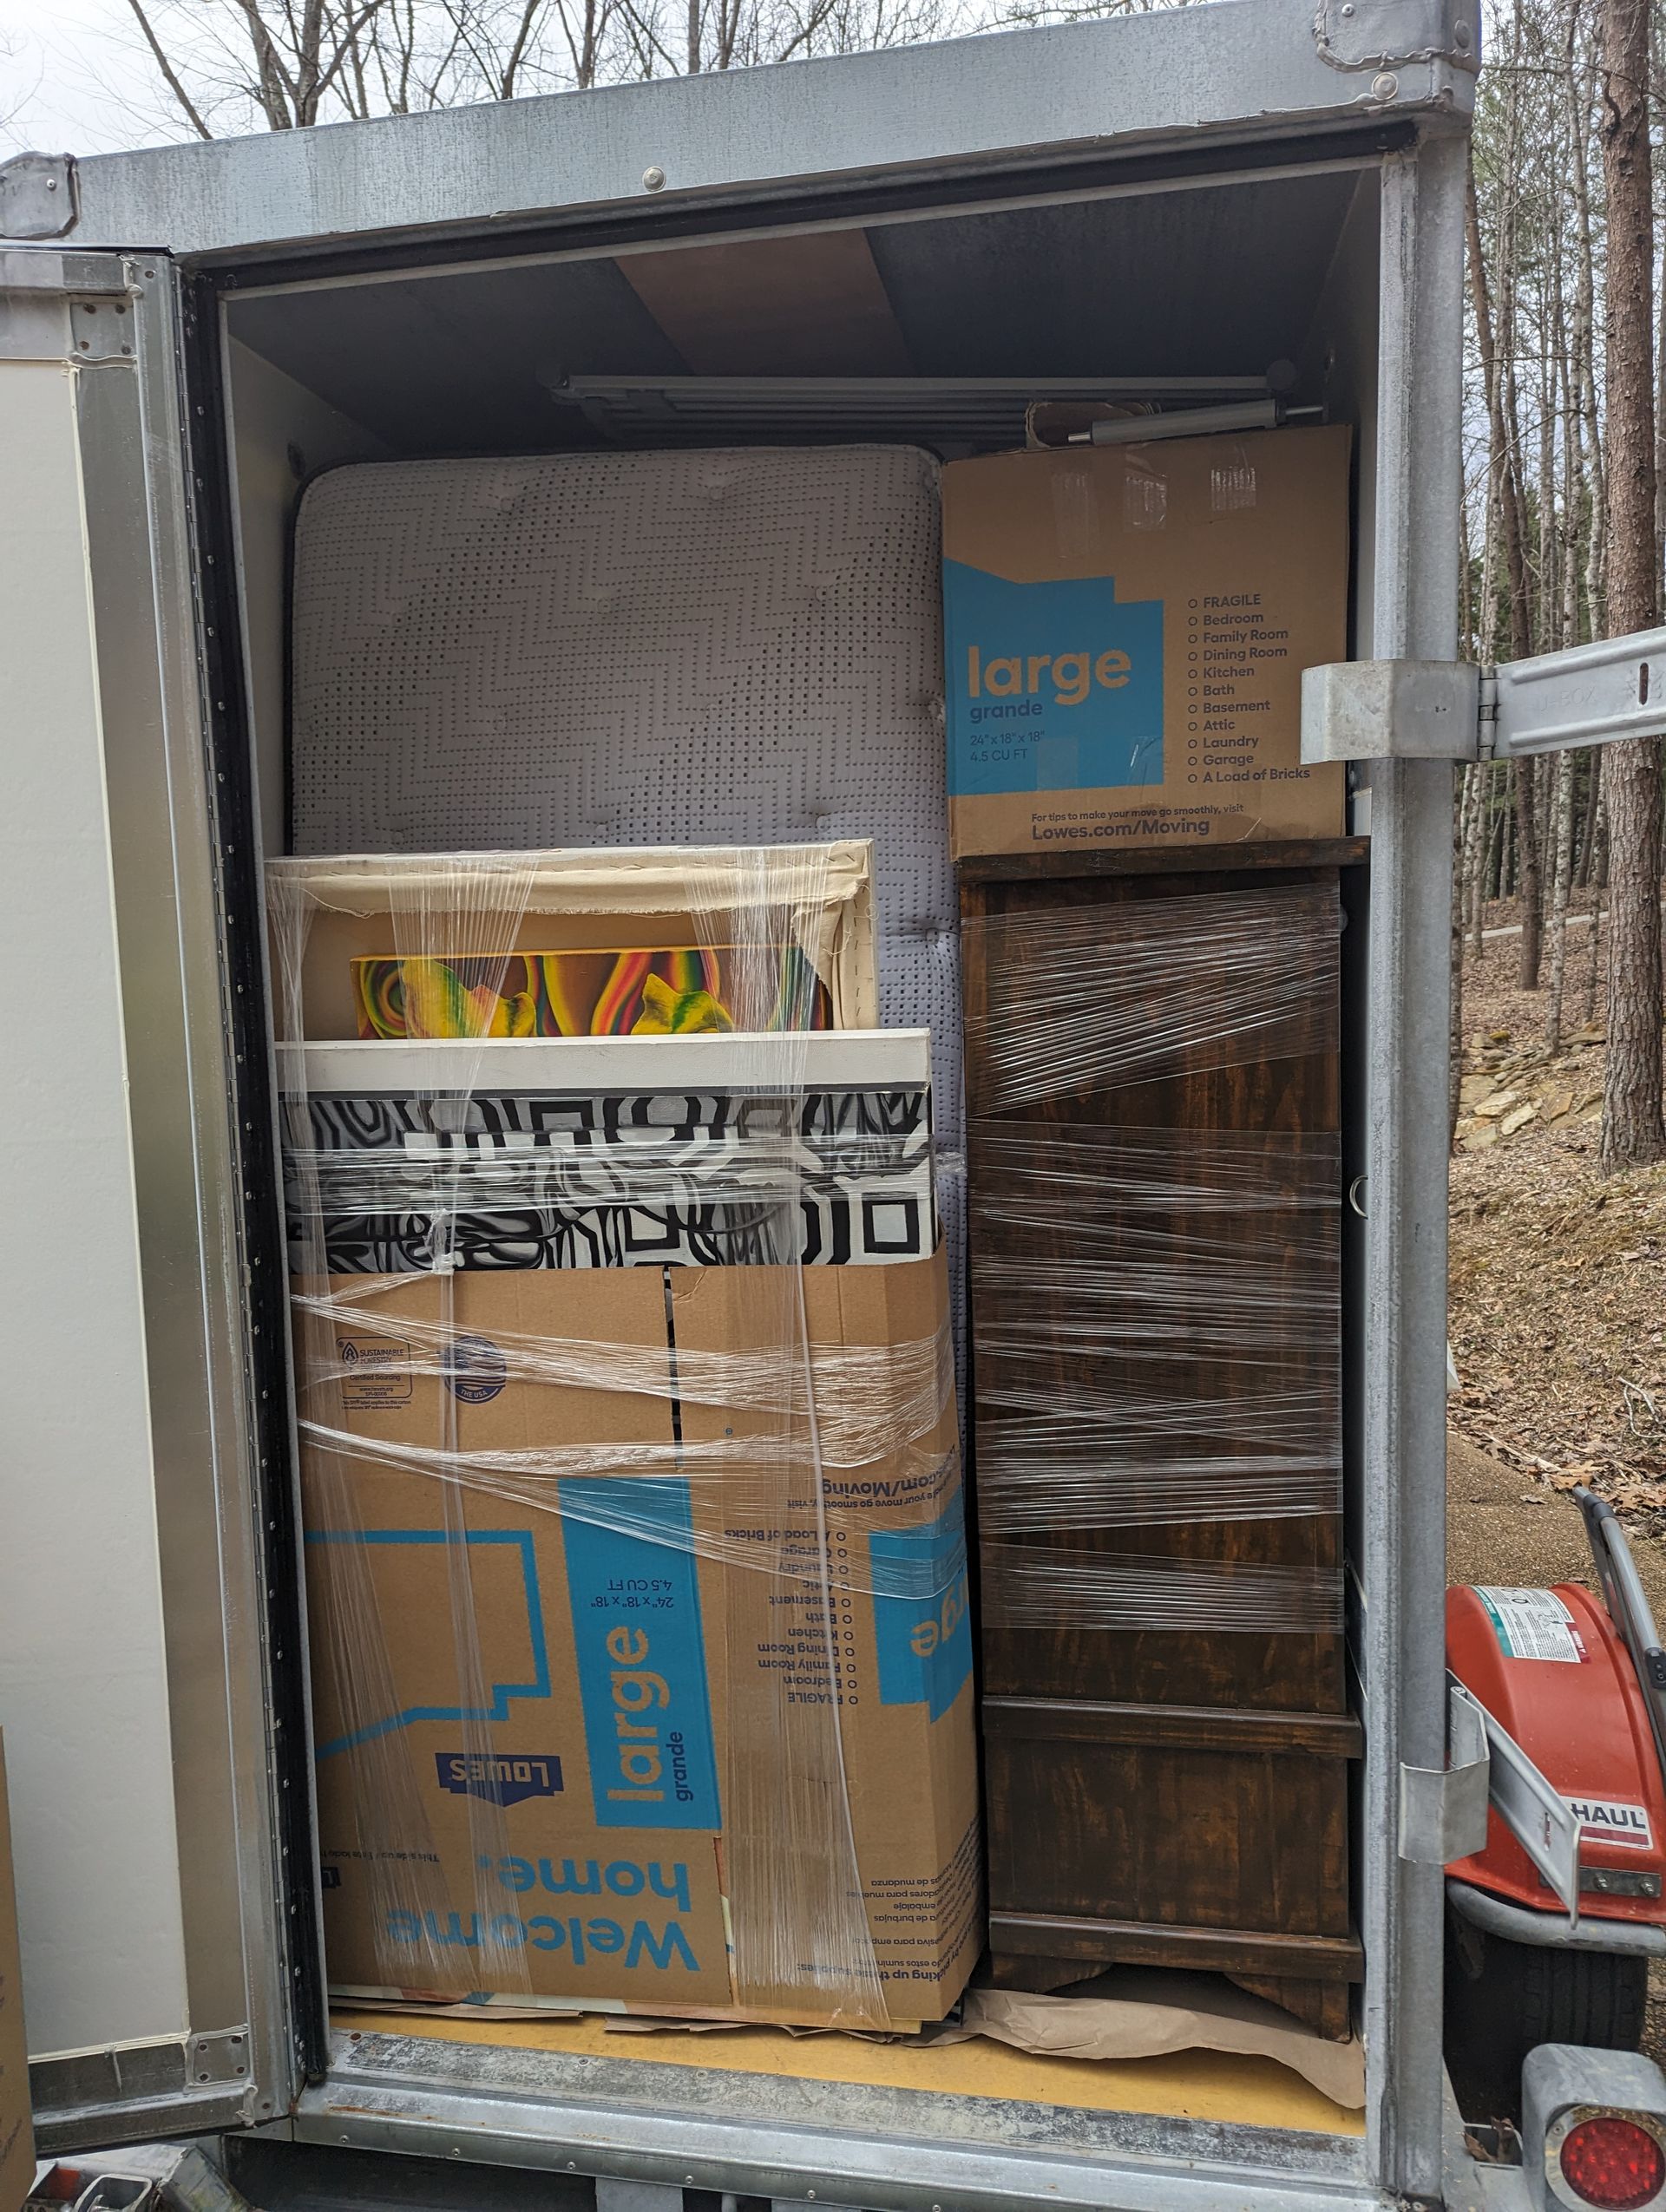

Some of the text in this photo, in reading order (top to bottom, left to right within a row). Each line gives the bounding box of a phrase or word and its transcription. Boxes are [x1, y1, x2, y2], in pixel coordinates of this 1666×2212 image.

[1204, 594, 1261, 607] FRAGILE
[1204, 612, 1264, 625] Bedroom
[1204, 628, 1289, 645] Family Room
[1204, 646, 1287, 663] Dining Room
[968, 645, 1131, 704] large
[1204, 665, 1255, 678] Kitchen
[1204, 684, 1235, 697] Bath
[970, 700, 1042, 723] grande
[1204, 700, 1270, 714] Basement
[1204, 719, 1235, 731] Attic
[970, 730, 1045, 746] 24" x 18" x 18"
[1204, 736, 1259, 751] Laundry
[970, 749, 1026, 762] 4.5 CU FT
[1204, 754, 1254, 768] Garage
[1204, 767, 1310, 783] A Load of Bricks
[1032, 804, 1243, 824] For tips to make your move go smoothly, visit
[1032, 818, 1210, 841] Lowes.com/Moving
[461, 1389, 472, 1397] THE
[860, 1499, 873, 1508] go
[876, 1499, 902, 1508] move
[904, 1493, 925, 1505] your
[725, 1529, 764, 1541] Bricks
[768, 1530, 780, 1541] of
[784, 1530, 817, 1541] Load
[607, 1580, 672, 1591] 4.5 CU FT
[590, 1596, 608, 1607] 18"
[622, 1596, 640, 1607] 18"
[653, 1596, 673, 1608] 24"
[788, 1628, 838, 1640] Ktchen
[758, 1643, 839, 1656] Room Dning
[758, 1660, 795, 1671] Room
[784, 1677, 842, 1689] Bedroom
[788, 1692, 843, 1705] FRAGILE
[607, 1626, 670, 1801] large
[671, 1731, 692, 1801] grande
[1571, 1803, 1646, 1829] HAUL
[477, 1855, 690, 1911] home.
[388, 1908, 699, 1971] Welcome
[892, 1971, 909, 1980] up
